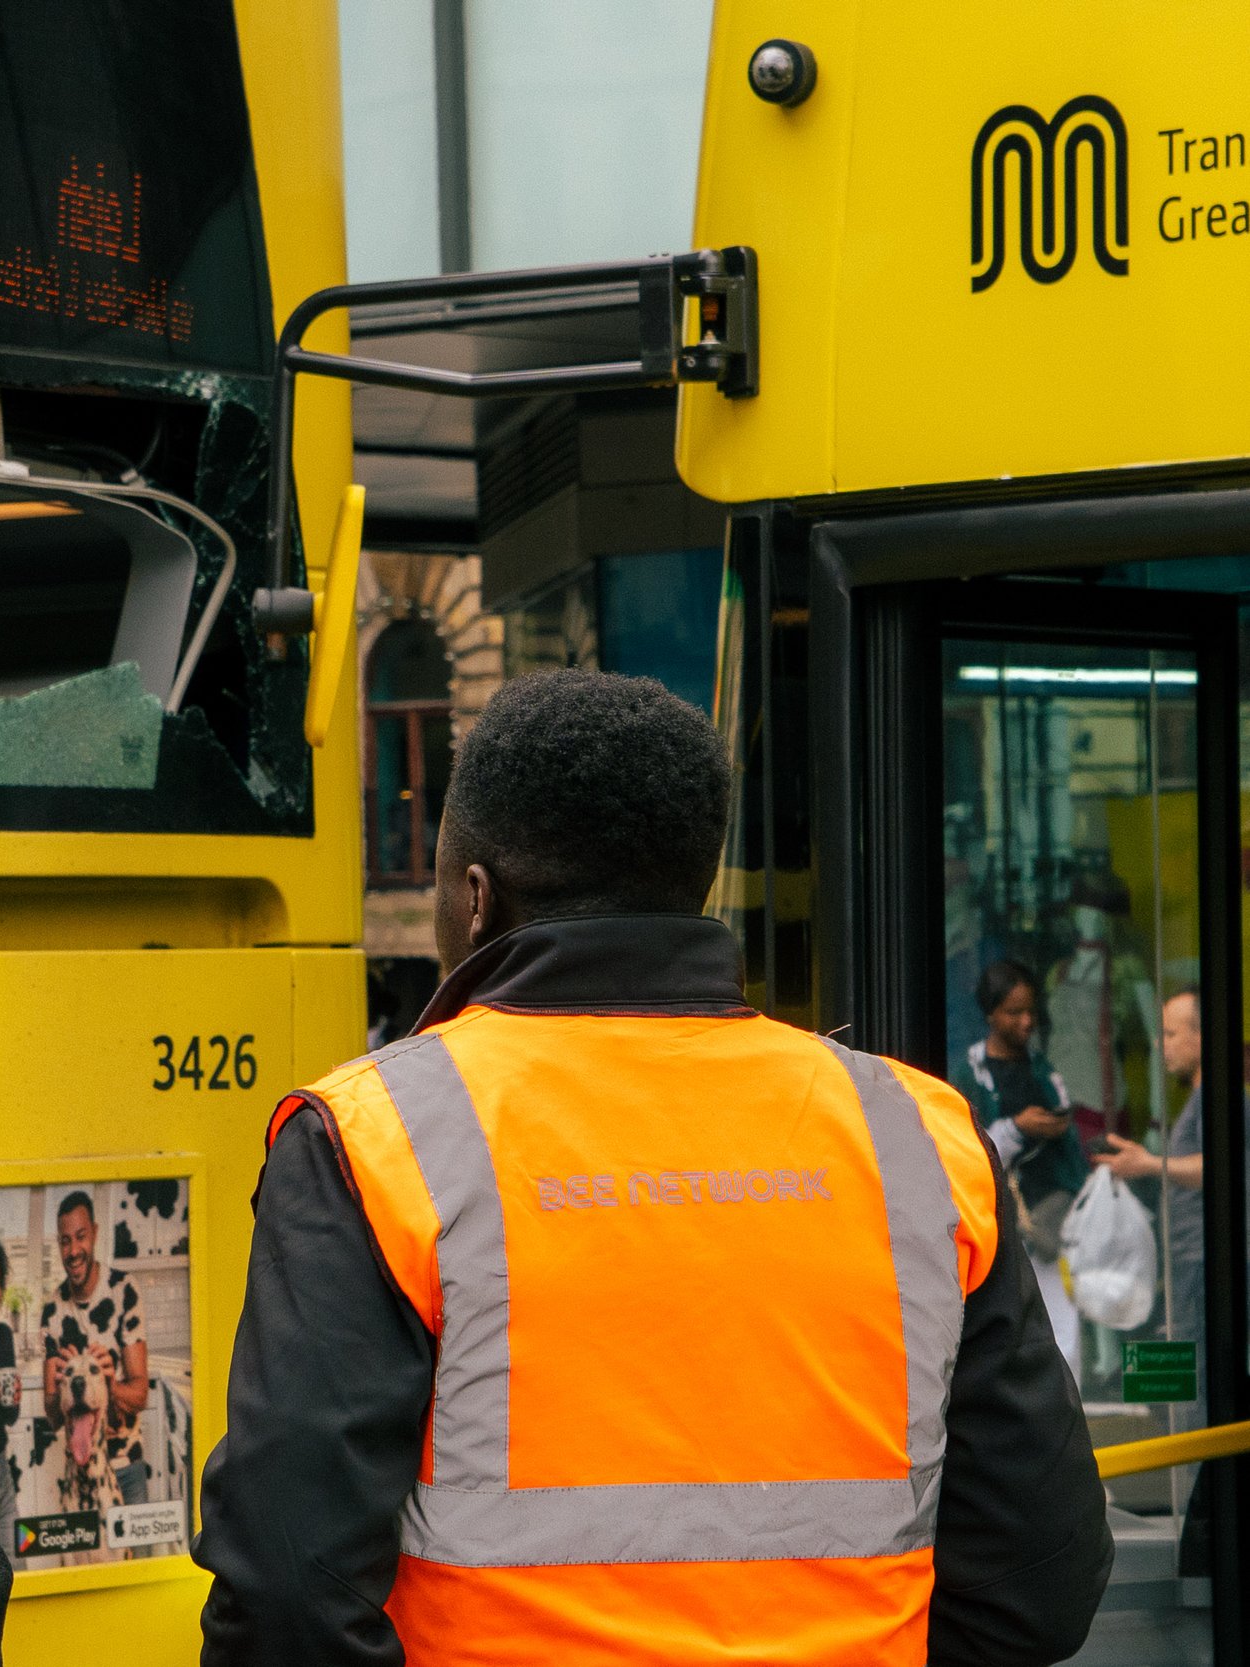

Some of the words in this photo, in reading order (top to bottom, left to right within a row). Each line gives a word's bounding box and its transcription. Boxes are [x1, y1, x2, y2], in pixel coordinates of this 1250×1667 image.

[1158, 127, 1245, 175] Tran
[1158, 195, 1250, 243] Grea
[152, 1033, 258, 1091] 3426
[537, 1175, 619, 1212] BEE
[627, 1167, 834, 1206] NETWORK
[38, 1529, 75, 1549] Google
[75, 1527, 97, 1545] Play
[130, 1523, 151, 1538] App
[153, 1519, 180, 1534] Store
